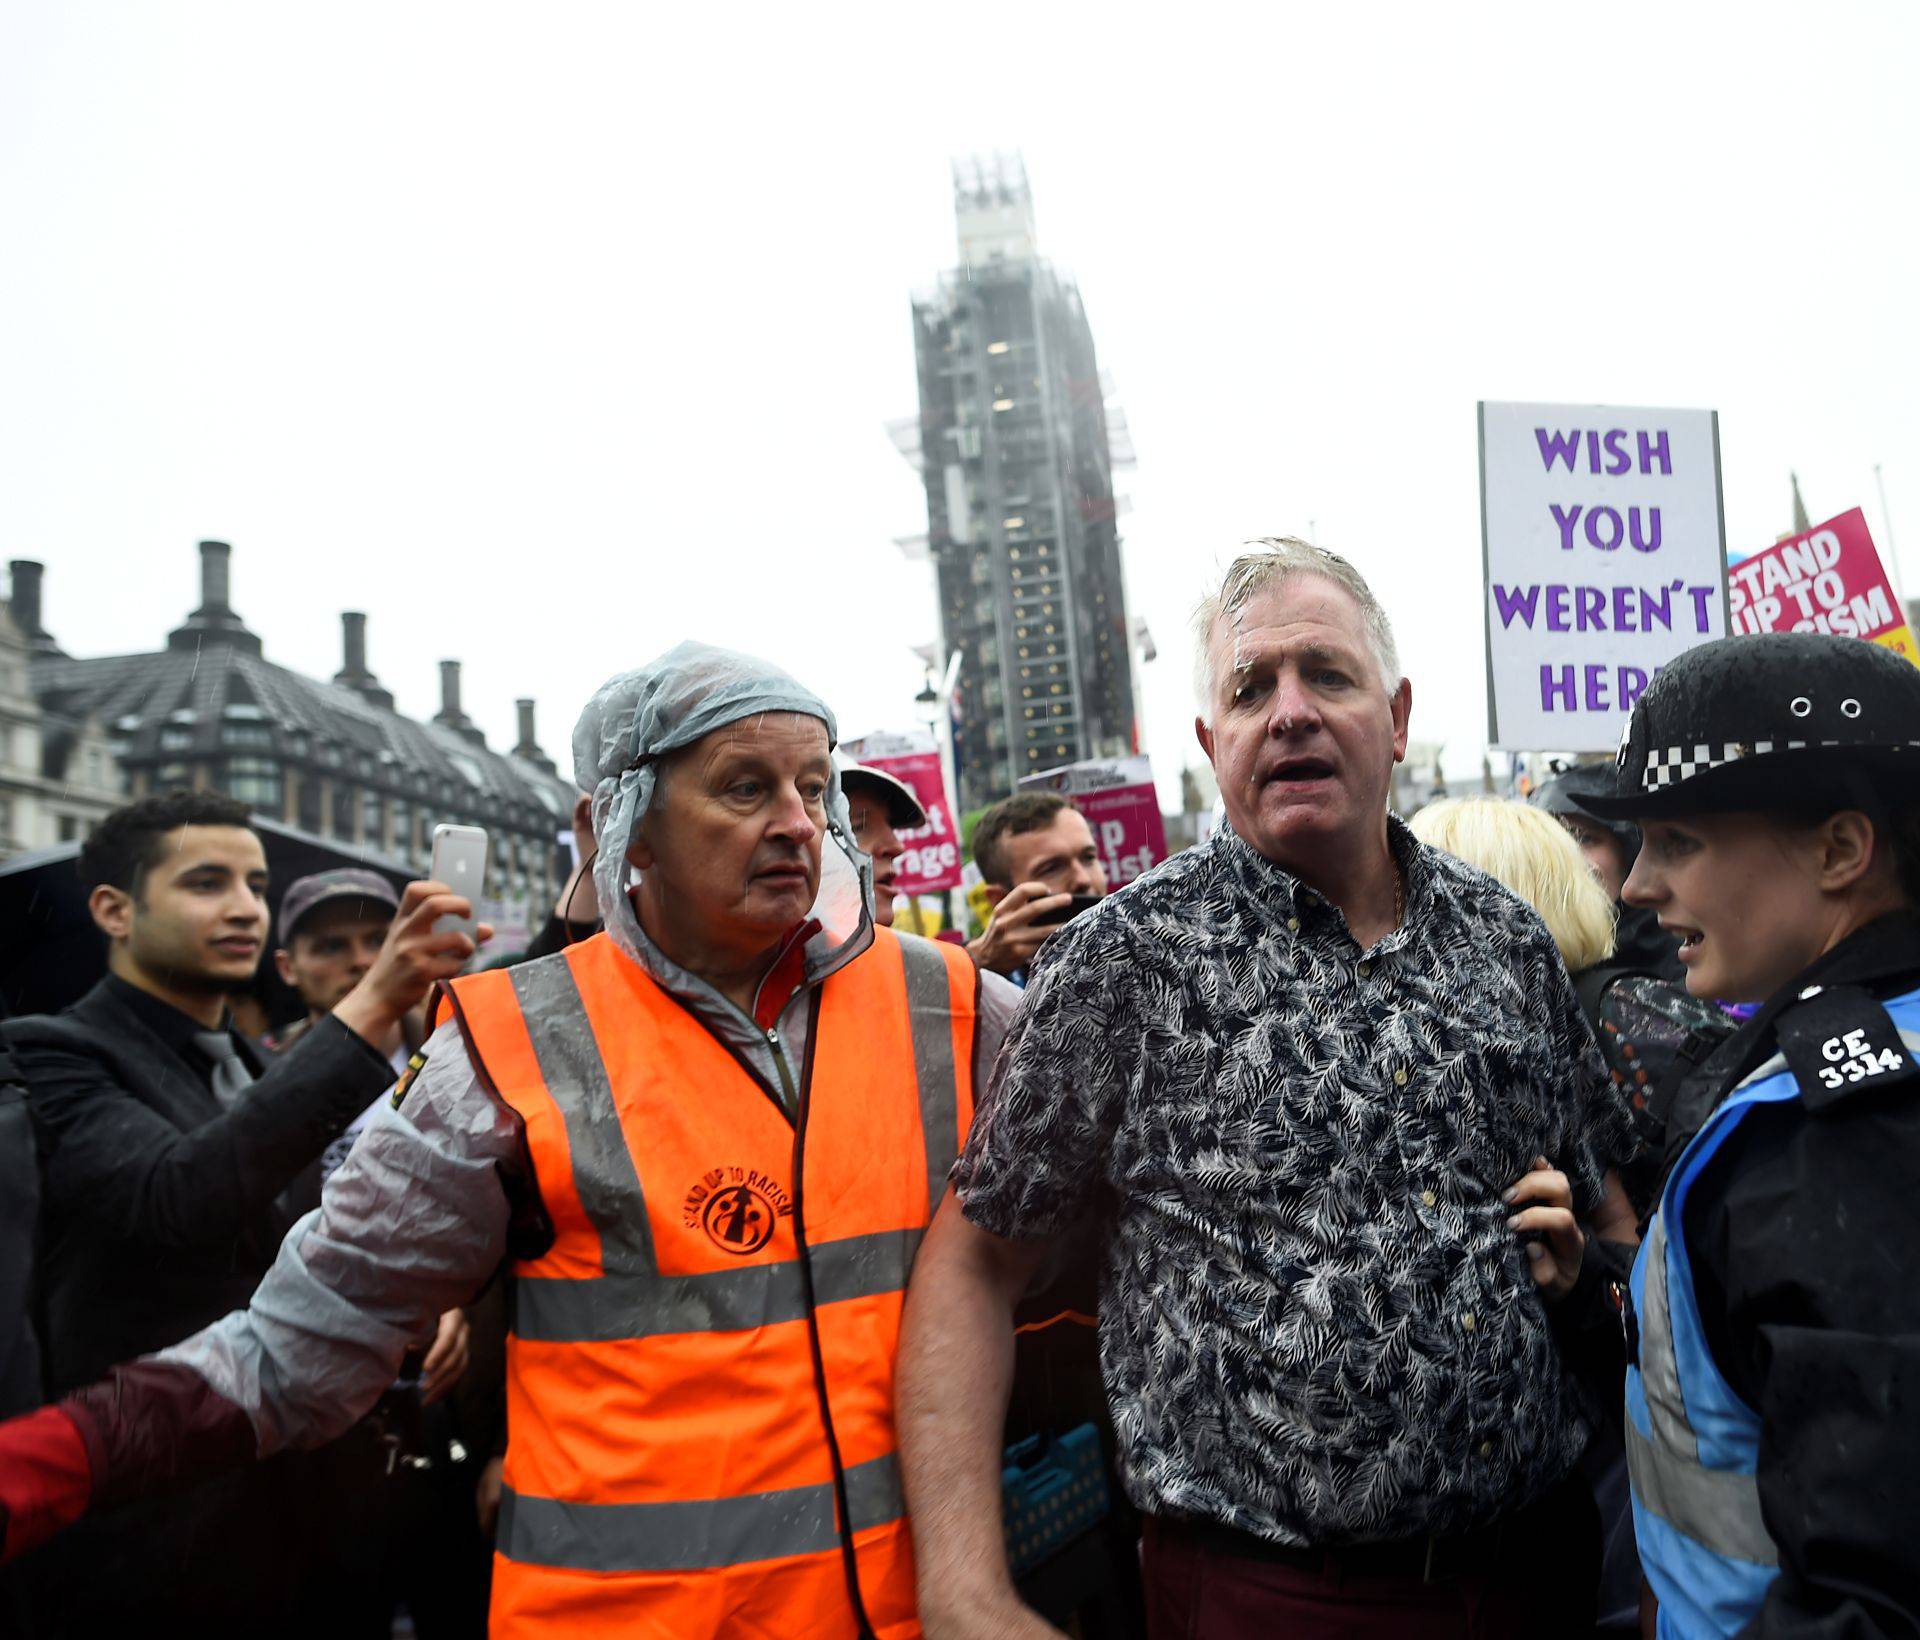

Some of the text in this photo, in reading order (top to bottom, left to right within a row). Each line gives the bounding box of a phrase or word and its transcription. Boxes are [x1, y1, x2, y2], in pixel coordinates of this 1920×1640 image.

[1535, 428, 1673, 476] WISH
[1549, 505, 1662, 553] YOU
[1730, 530, 1842, 615] STAND
[1785, 570, 1846, 619] TO
[1493, 580, 1715, 634] WEREN'T
[1540, 664, 1665, 712] HER
[1818, 1047, 1903, 1089] 3314
[1821, 1028, 1871, 1062] CE
[746, 1170, 795, 1217] RACISM
